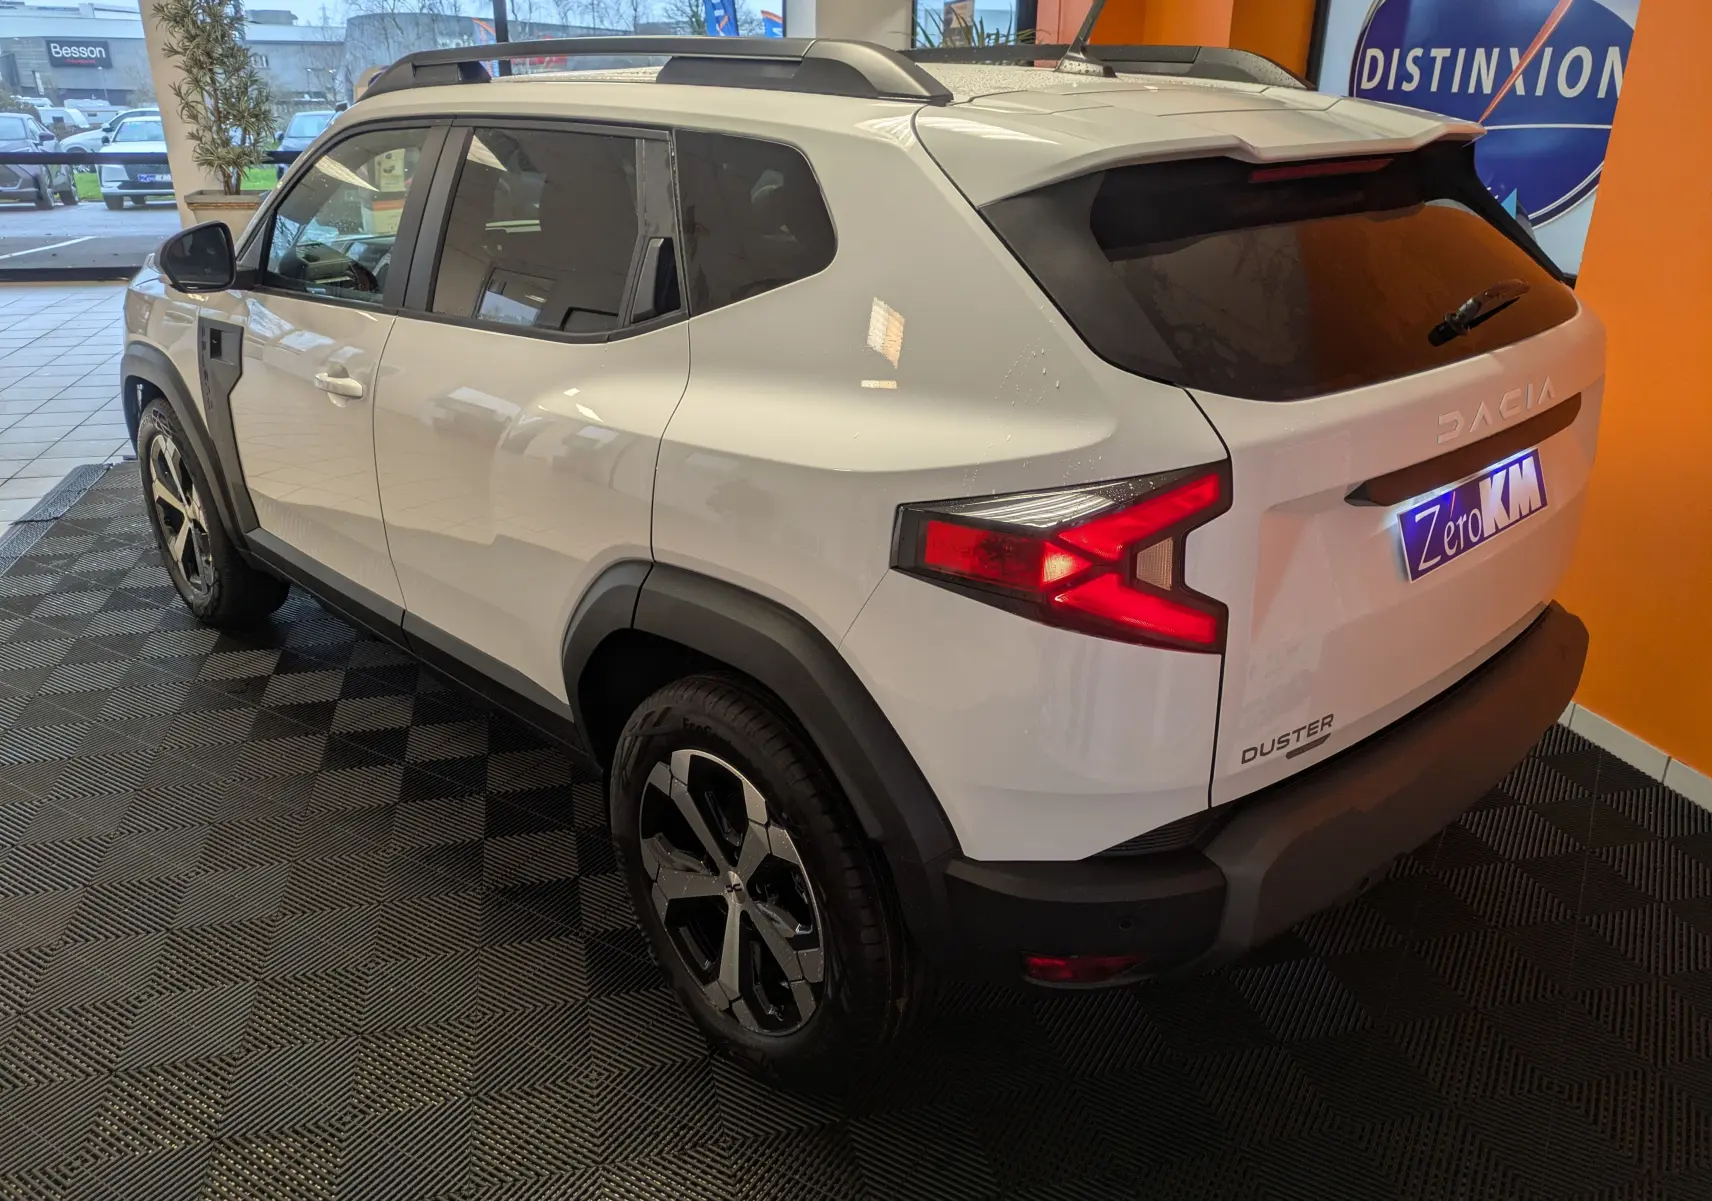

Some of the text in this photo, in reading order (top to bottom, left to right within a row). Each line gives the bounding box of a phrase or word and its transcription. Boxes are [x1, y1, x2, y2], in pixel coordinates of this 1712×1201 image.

[50, 43, 106, 58] Besson
[1360, 46, 1623, 99] DISTINXION
[1437, 376, 1556, 443] DACIA
[1241, 713, 1334, 765] DUSTER
